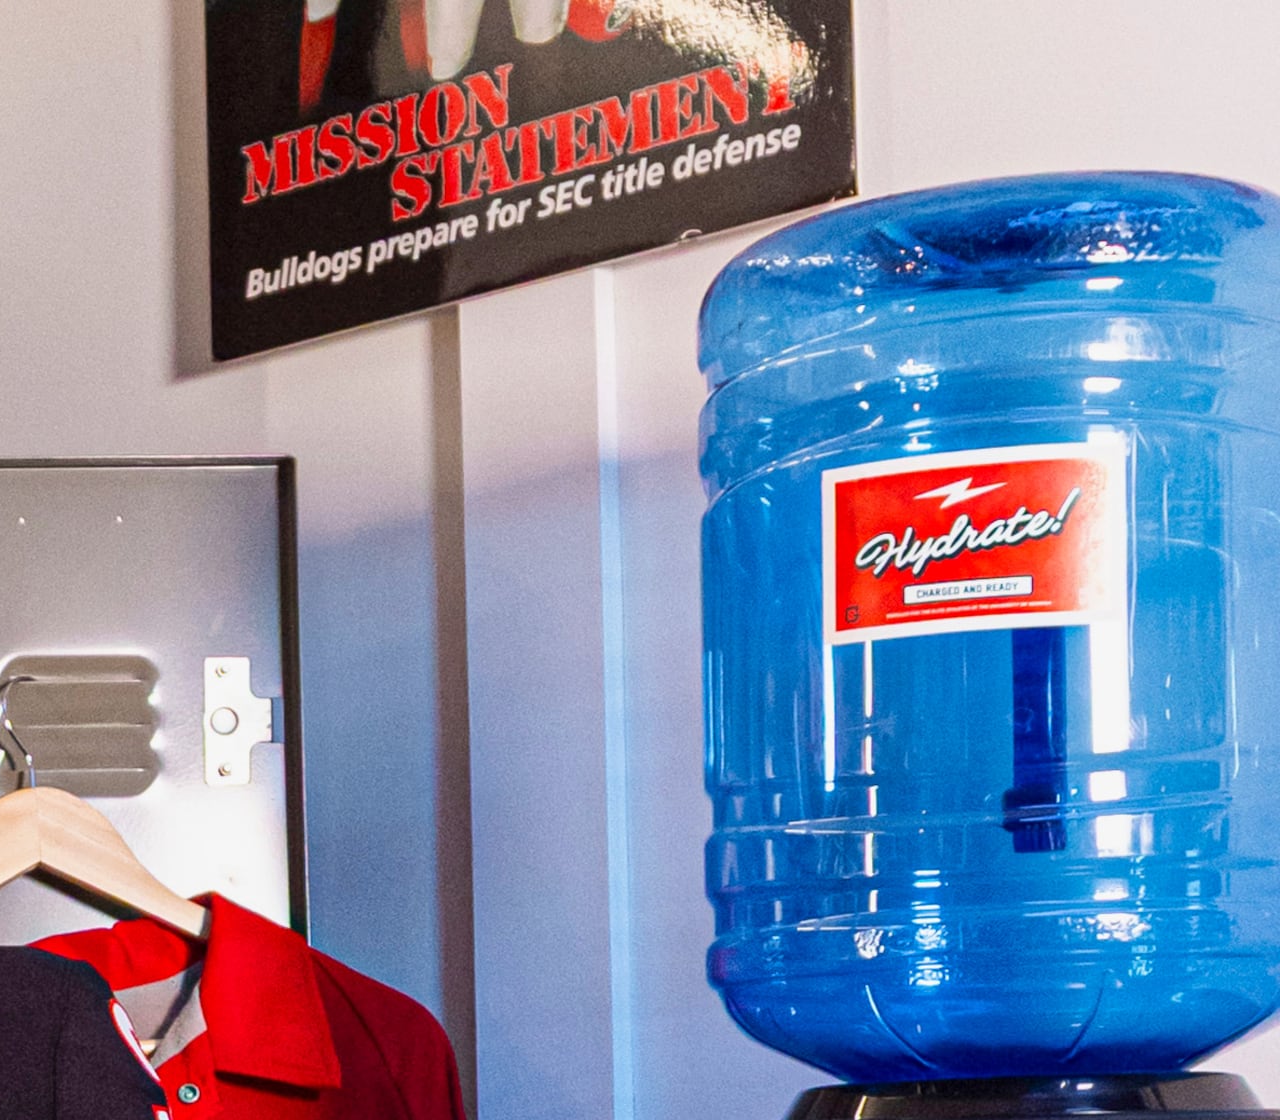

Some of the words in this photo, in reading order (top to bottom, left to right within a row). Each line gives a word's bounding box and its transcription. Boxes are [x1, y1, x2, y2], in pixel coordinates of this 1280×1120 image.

[241, 62, 515, 204] MISSION
[391, 40, 806, 220] STATEMENT
[246, 243, 362, 299] Bulldogs
[367, 214, 478, 273] prepare
[486, 192, 532, 232] for
[538, 174, 594, 218] SEC
[601, 153, 664, 201] title
[673, 123, 801, 181] defense
[855, 487, 1082, 578] Hydrate!
[916, 586, 960, 599] CHARGED
[963, 584, 982, 595] AND
[986, 582, 1019, 593] READY
